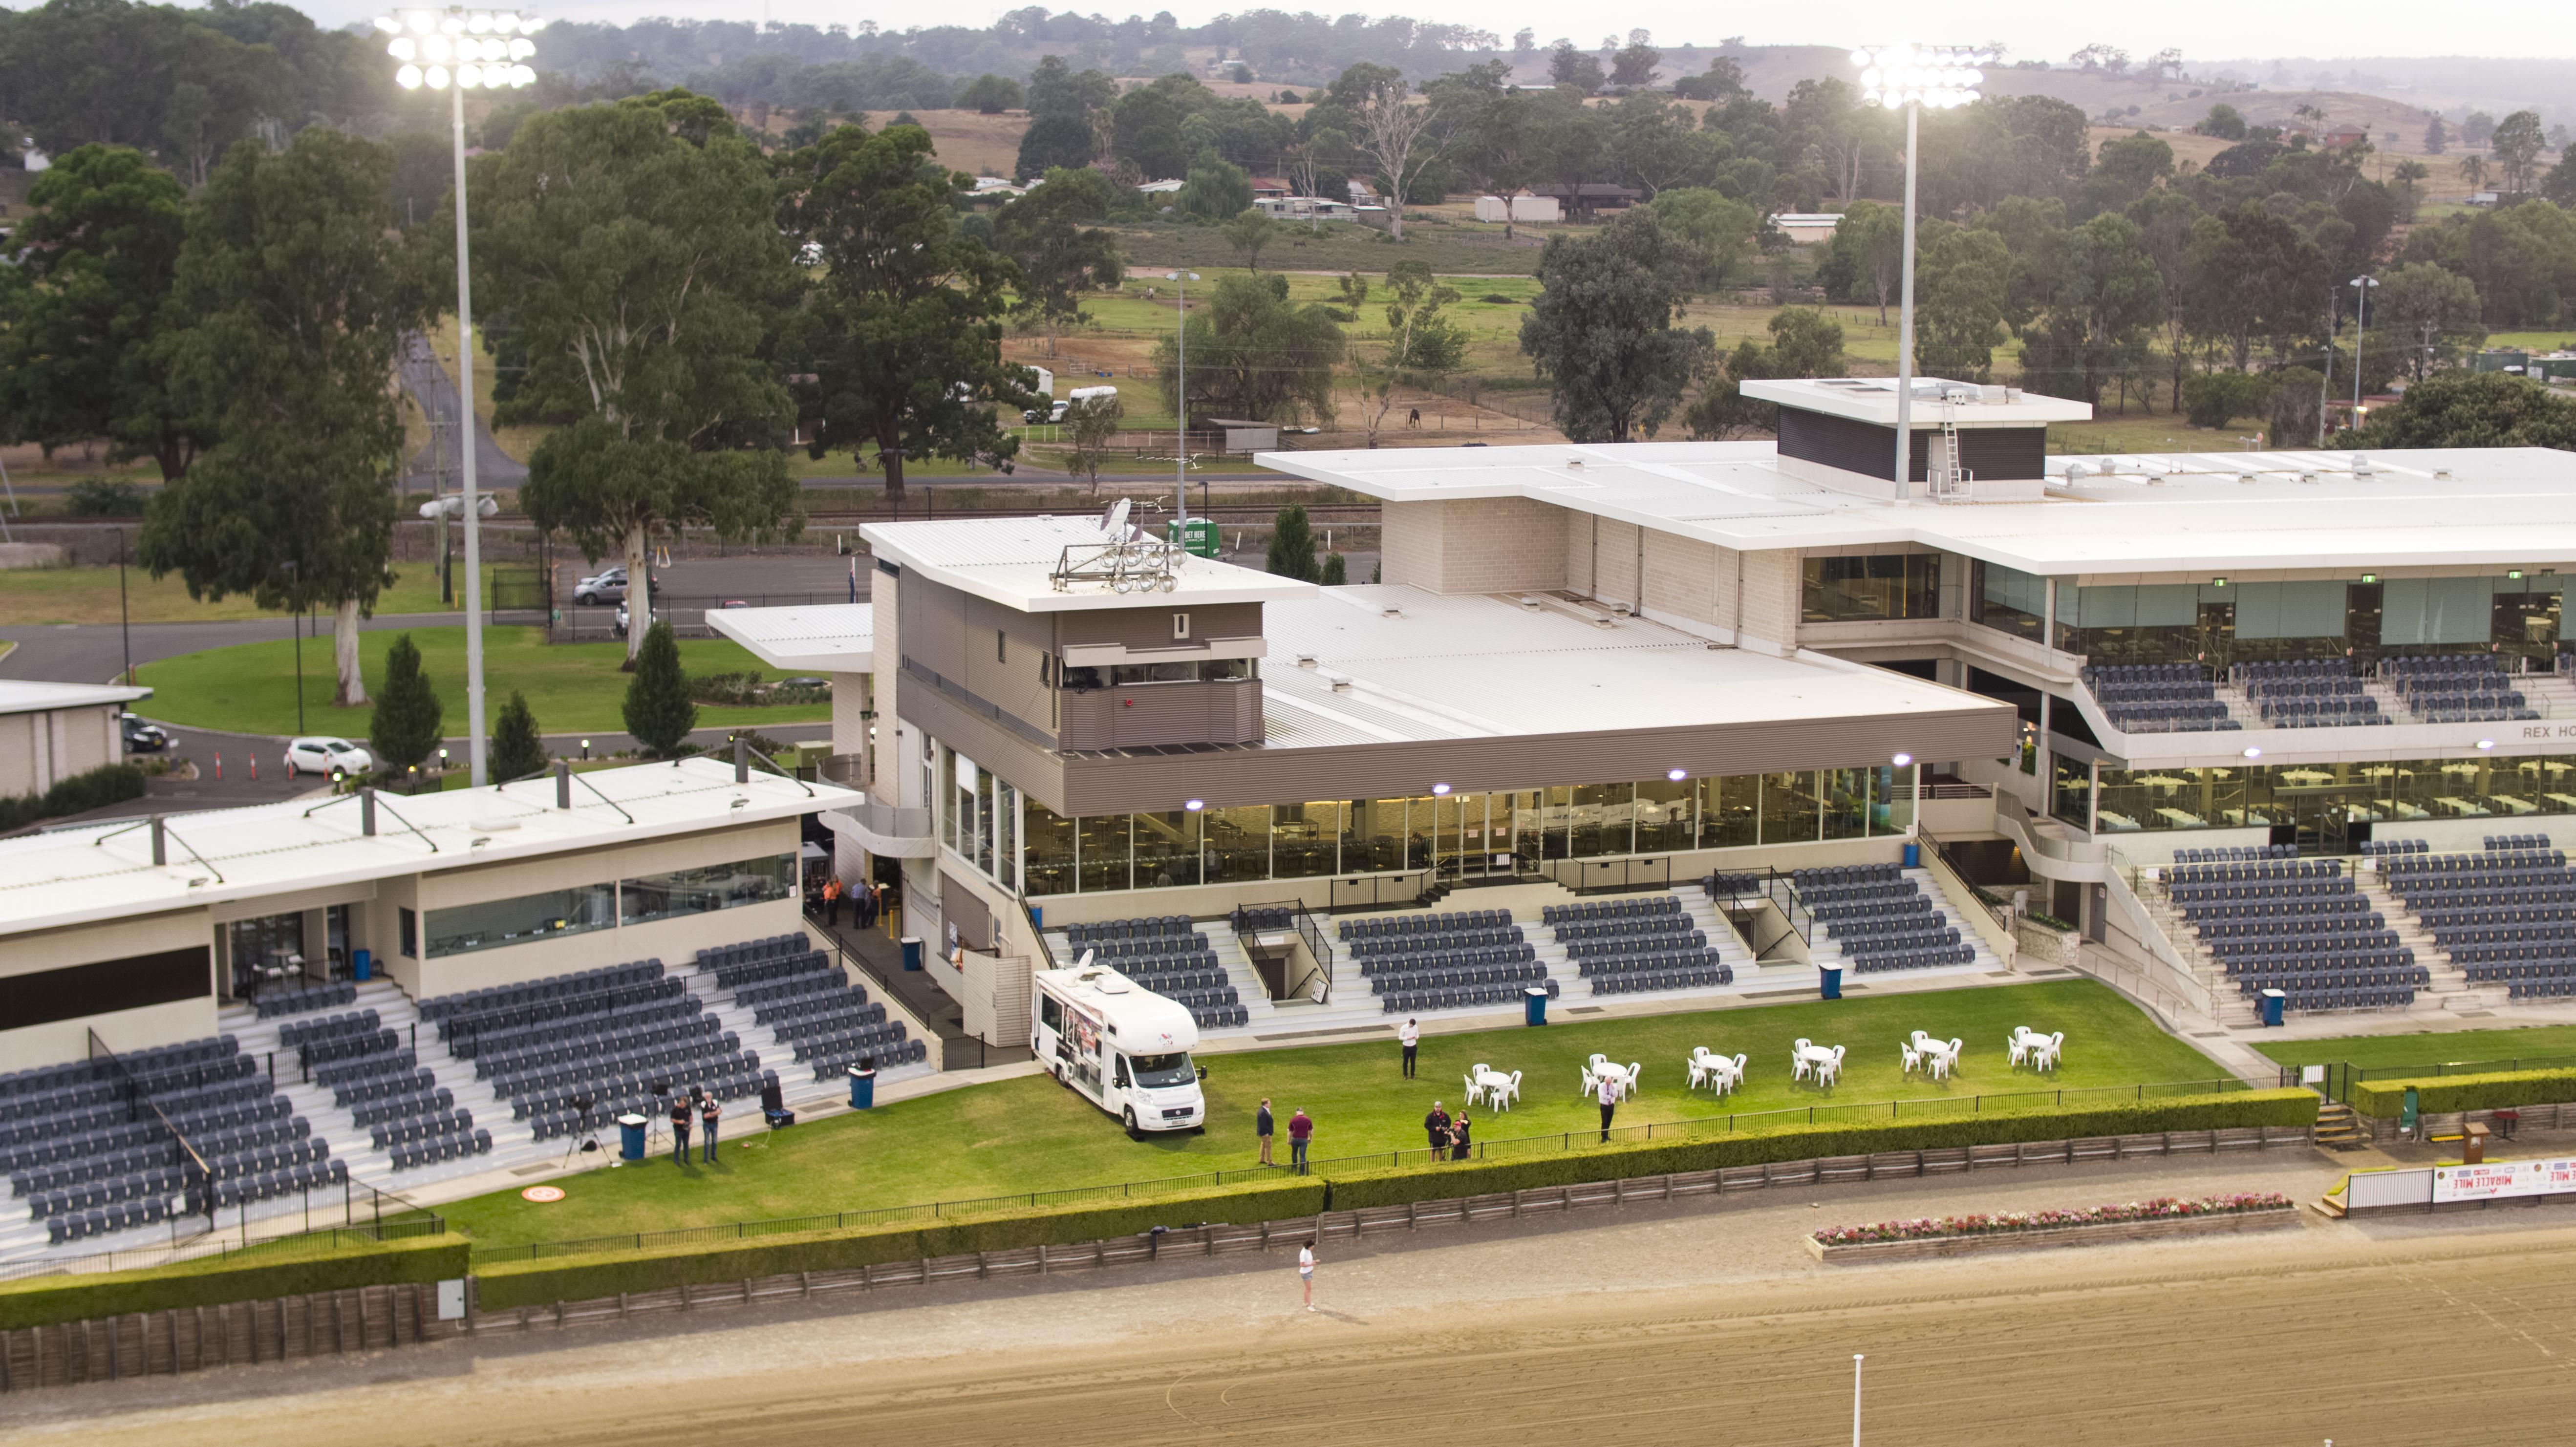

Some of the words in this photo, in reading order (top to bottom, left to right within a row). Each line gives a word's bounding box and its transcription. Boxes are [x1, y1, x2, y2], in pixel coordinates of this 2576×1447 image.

[2523, 726, 2550, 738] REX
[2550, 1170, 2570, 1181] MILE
[2453, 1178, 2473, 1189] MILE
[2476, 1175, 2512, 1188] MIRACLE
